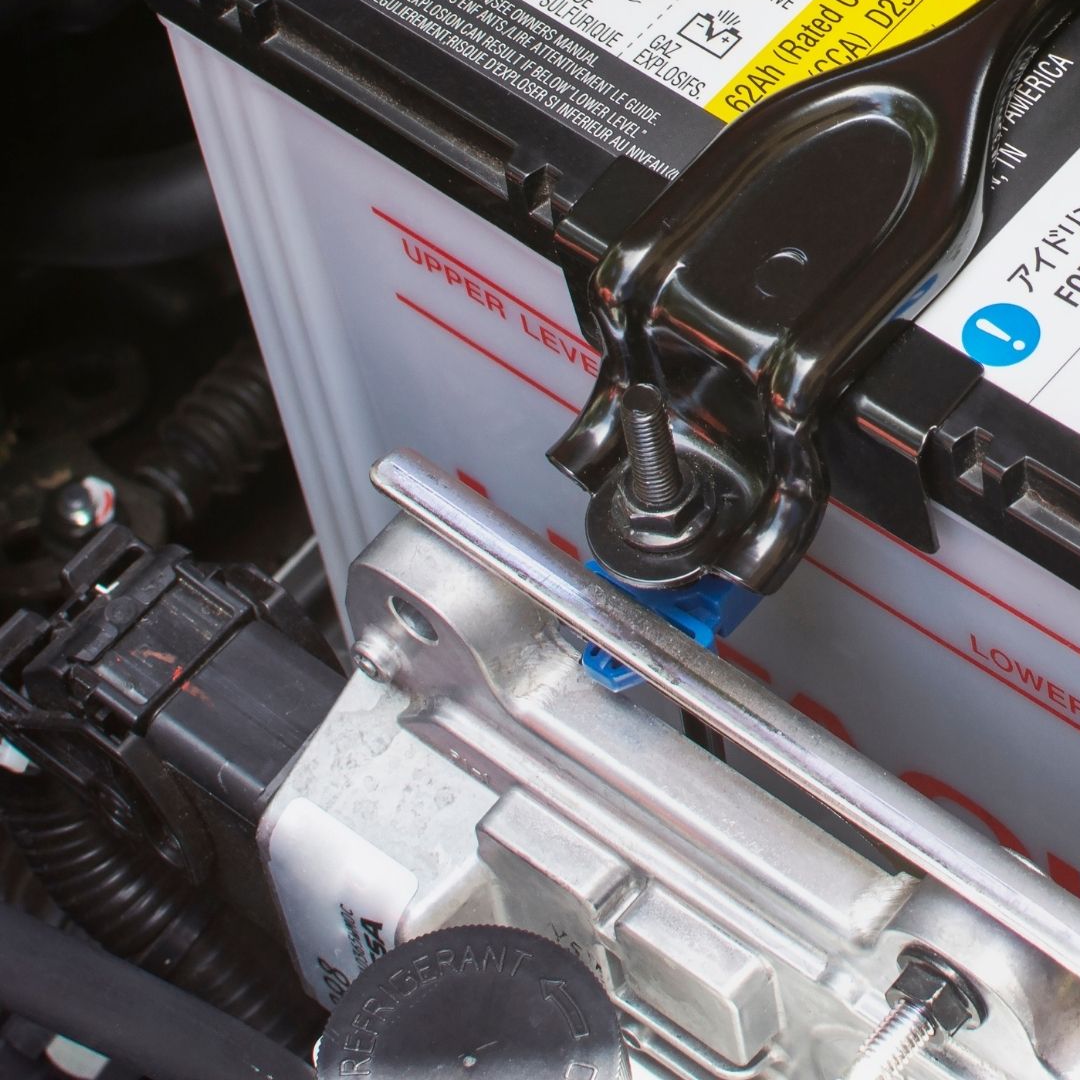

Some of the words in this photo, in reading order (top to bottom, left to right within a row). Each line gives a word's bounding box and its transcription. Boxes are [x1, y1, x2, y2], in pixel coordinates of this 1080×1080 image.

[459, 21, 487, 43] CAN
[480, 34, 526, 65] RESULT
[518, 58, 537, 72] IF
[509, 7, 558, 41] OWNERS
[552, 33, 599, 68] MANUAL
[648, 33, 682, 59] GAZ
[724, 64, 785, 116] 62Ah
[772, 3, 844, 65] (Rated
[529, 41, 615, 95] ATTENTIVEMENT
[608, 88, 629, 105] LE
[623, 97, 662, 126] GUIDE.
[631, 47, 706, 100] EXPLOSIFS.
[1005, 53, 1074, 124] AMERICA
[543, 94, 561, 110] SI
[555, 101, 613, 142] INFERIEUR
[607, 134, 631, 152] AU
[401, 237, 507, 320] UPPER
[520, 314, 600, 378] LEVE
[339, 944, 535, 1077] REFRIGERANT
